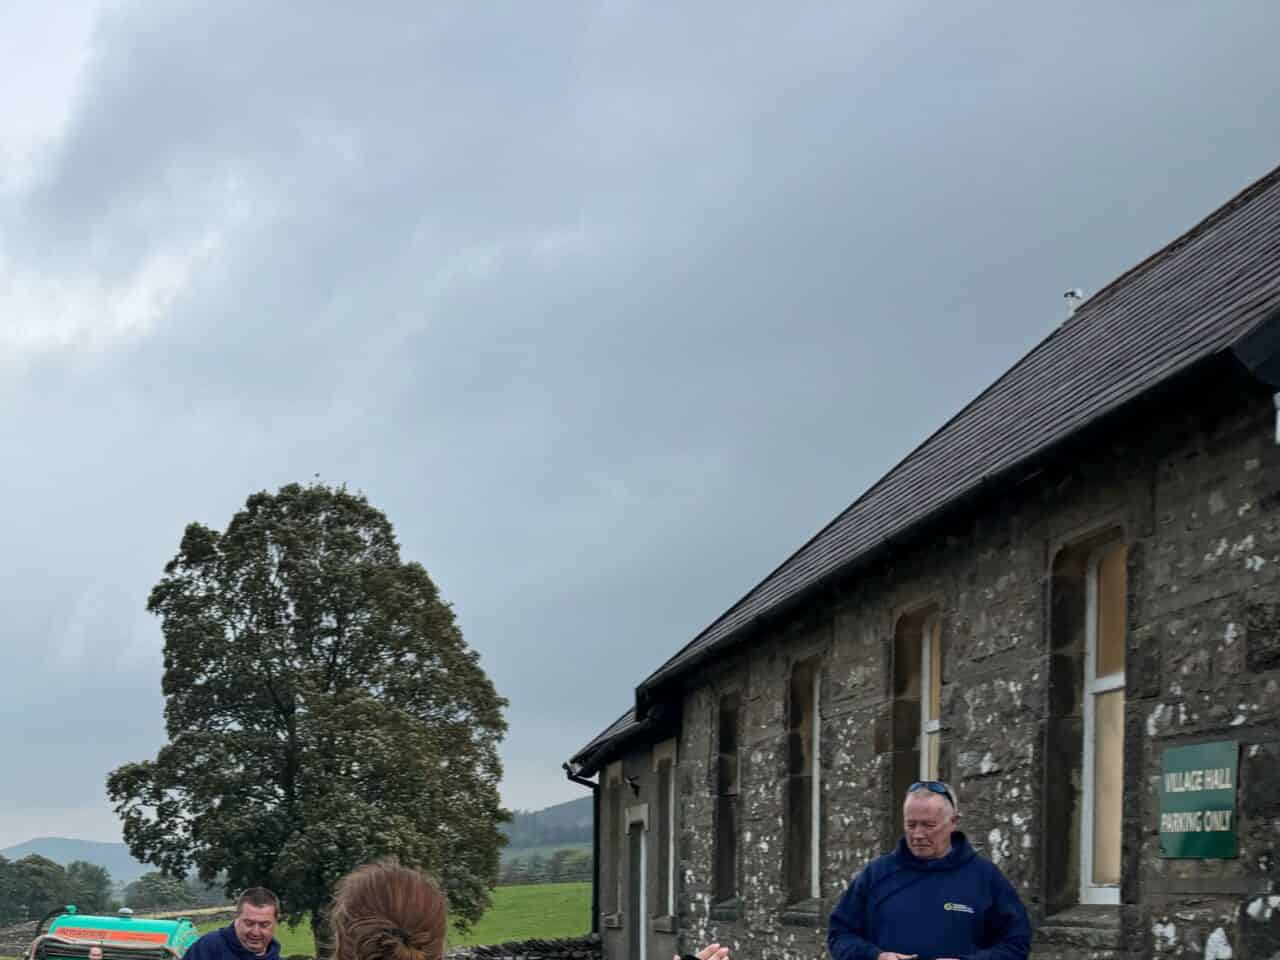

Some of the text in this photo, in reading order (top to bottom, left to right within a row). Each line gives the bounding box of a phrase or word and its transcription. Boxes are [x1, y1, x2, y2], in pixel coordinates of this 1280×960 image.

[1165, 768, 1232, 792] VILLAGE HALL
[1161, 810, 1232, 832] PARKING ONLY
